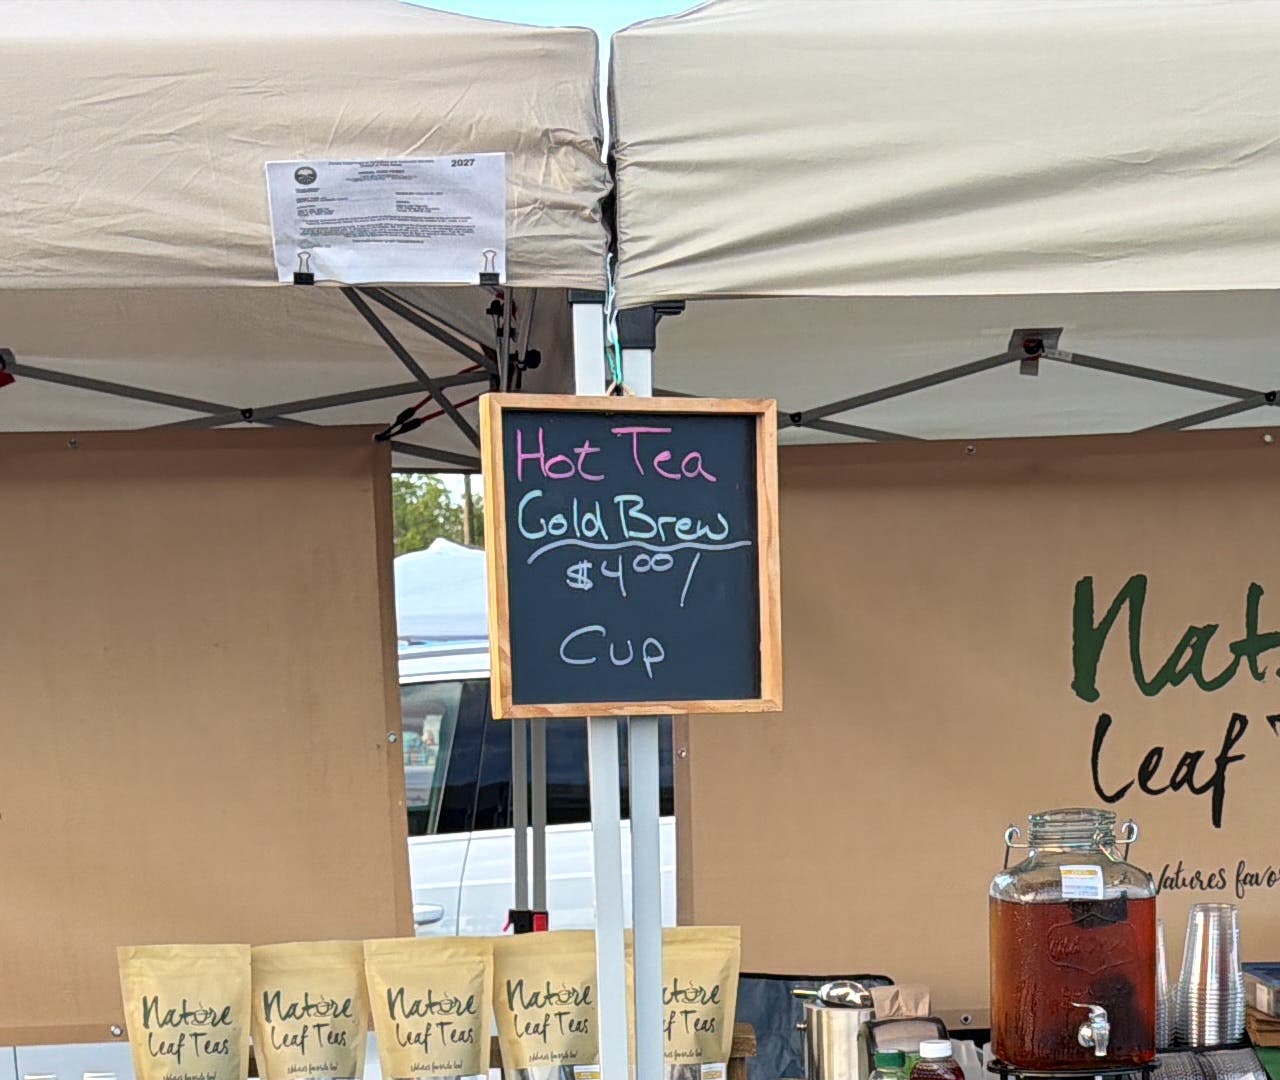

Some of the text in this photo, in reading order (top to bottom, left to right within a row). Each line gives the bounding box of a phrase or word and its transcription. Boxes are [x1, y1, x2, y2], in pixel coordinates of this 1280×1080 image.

[451, 159, 476, 167] 2027
[517, 426, 717, 482] Hot Tea
[518, 490, 729, 541] Cold Brew
[560, 625, 665, 679] Cup
[1091, 713, 1248, 828] Leaf
[263, 991, 352, 1023] Nature
[386, 987, 477, 1021] Nature
[506, 979, 592, 1011] Nature
[663, 977, 720, 1005] ture
[142, 996, 232, 1029] Nature
[514, 1012, 588, 1044] Leaf Teas
[680, 1010, 715, 1034] Teas
[148, 1032, 229, 1064] Leaf Teas
[270, 1023, 347, 1055] Leaf Teas
[396, 1021, 474, 1053] Leaf Teas
